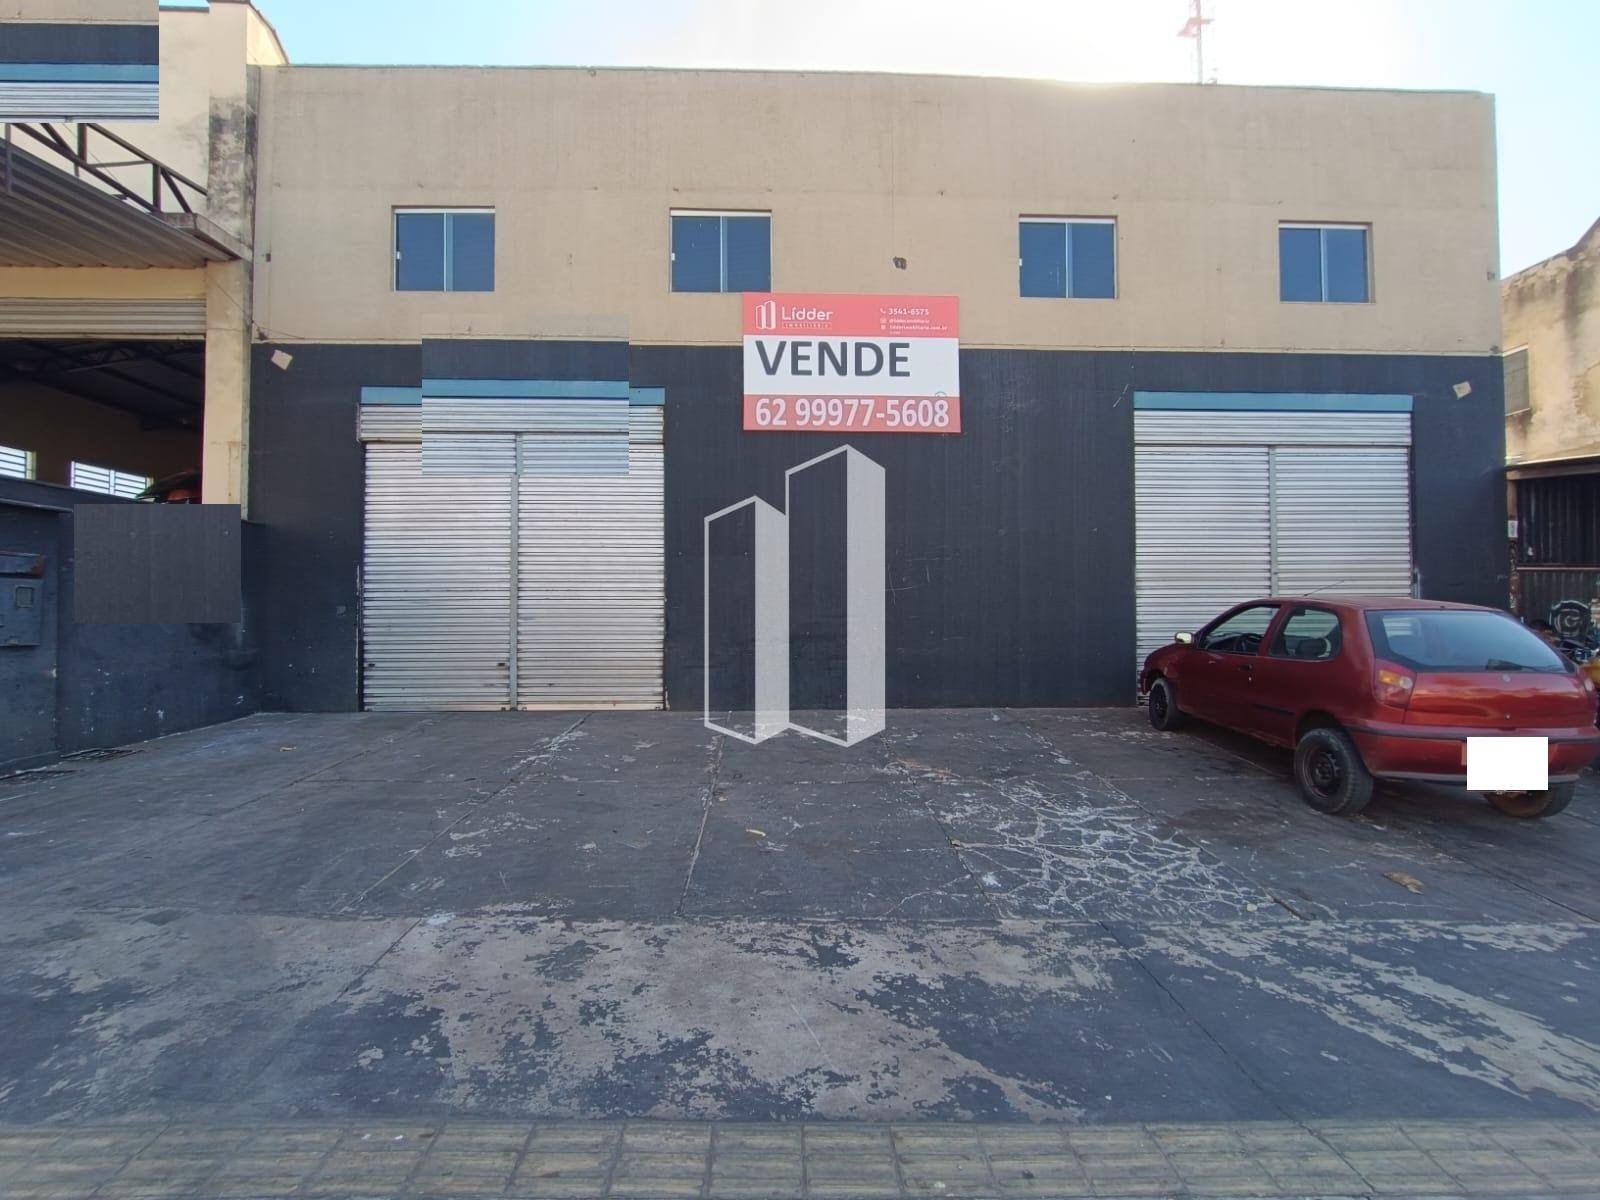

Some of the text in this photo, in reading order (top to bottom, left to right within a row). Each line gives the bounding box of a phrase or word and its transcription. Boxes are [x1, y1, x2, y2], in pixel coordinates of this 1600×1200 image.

[755, 340, 911, 378] VENDE
[755, 397, 949, 427] 62 99977-5608
